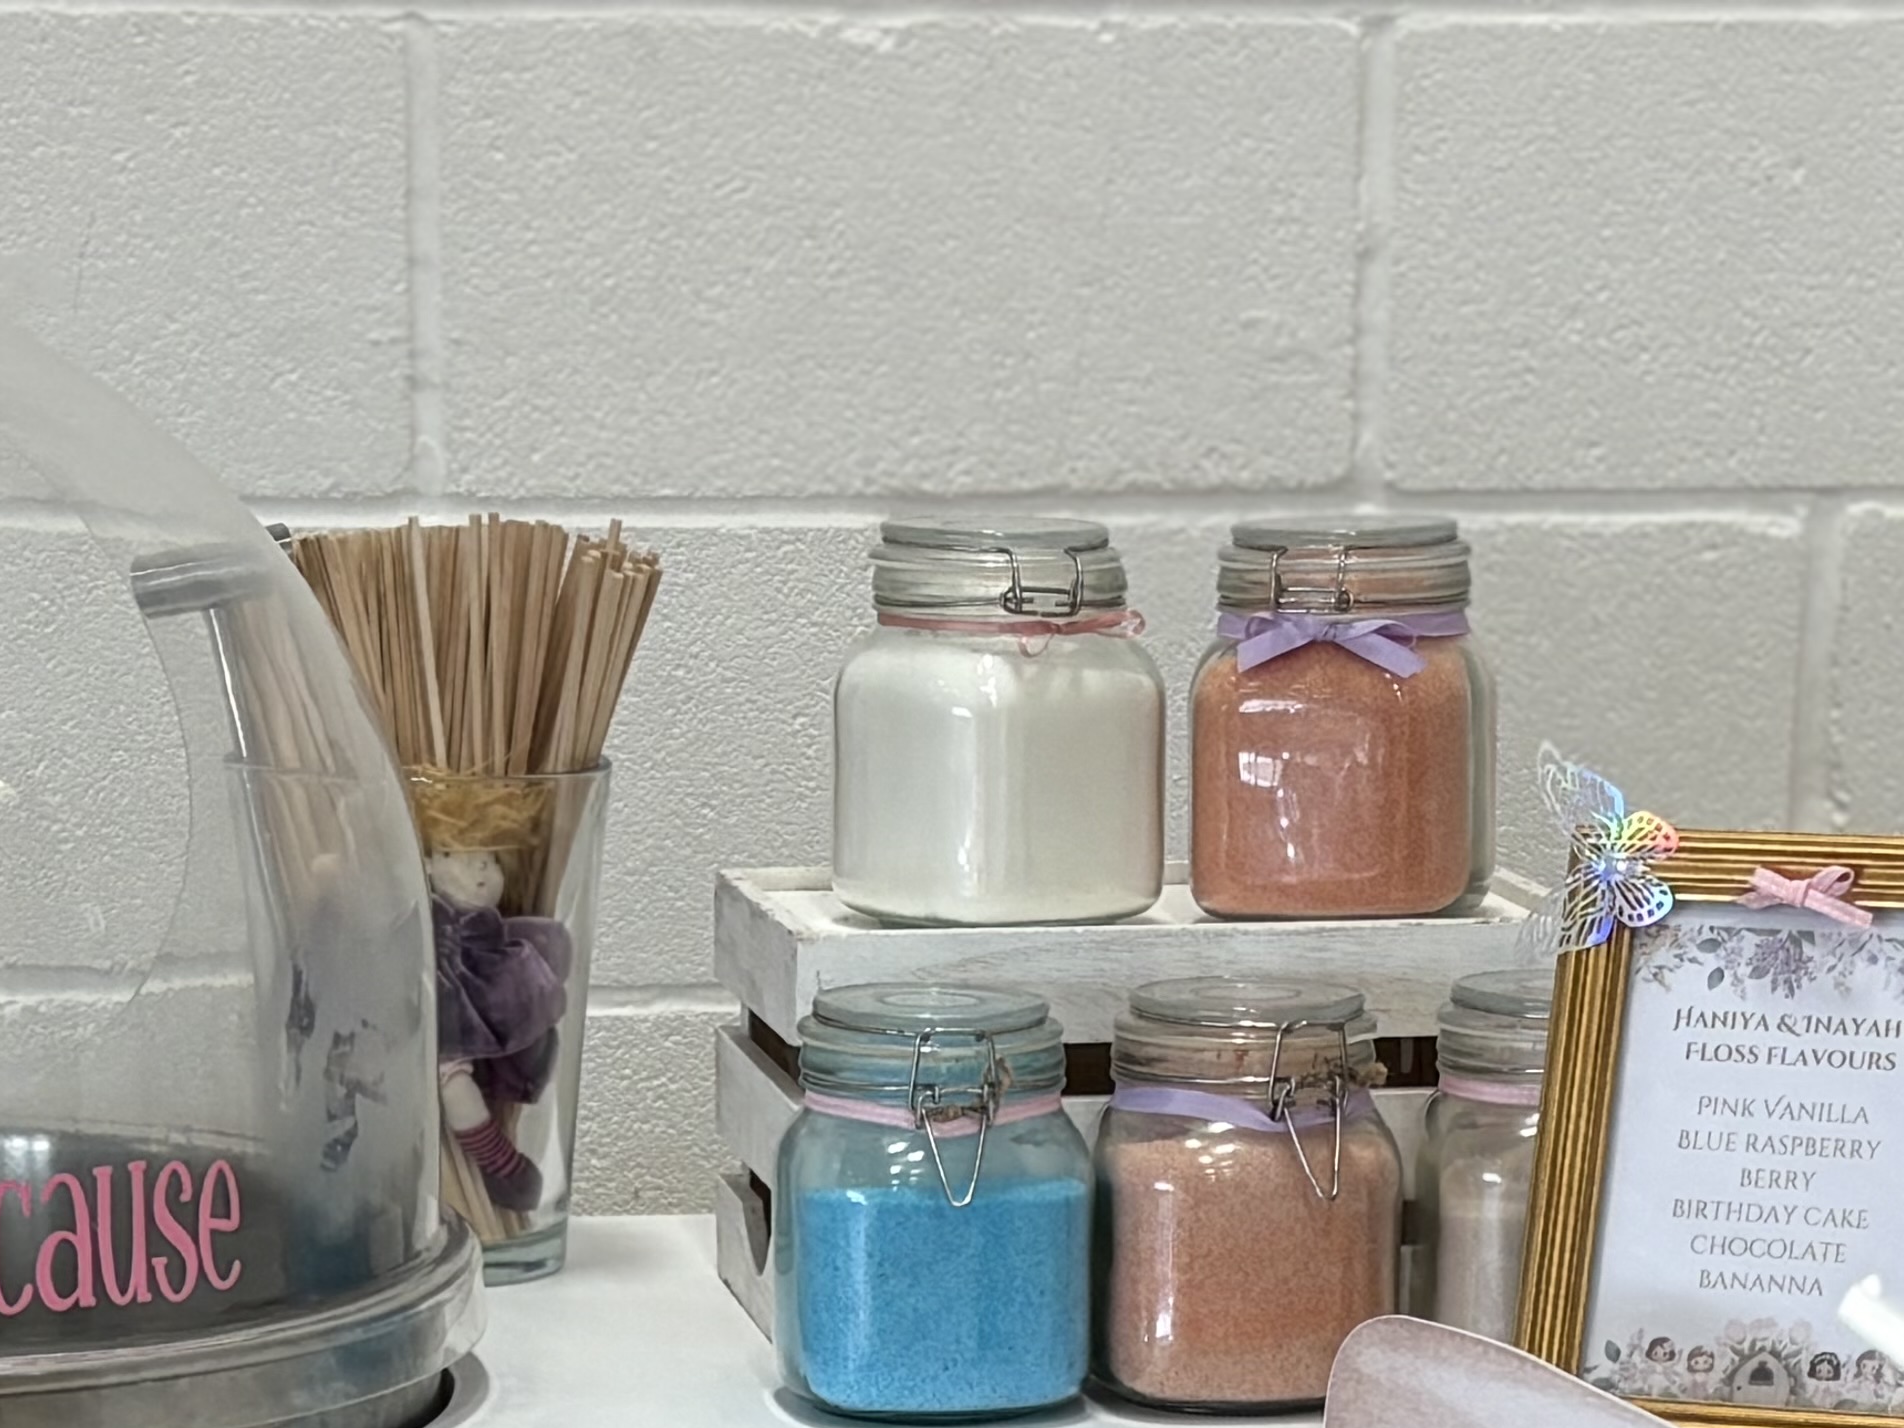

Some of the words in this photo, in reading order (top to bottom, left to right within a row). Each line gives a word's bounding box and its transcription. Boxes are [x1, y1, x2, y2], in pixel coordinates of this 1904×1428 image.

[1673, 1006, 1769, 1032] HANIYA
[1776, 1013, 1801, 1037] &
[1685, 1041, 1759, 1065] FLOSS
[1766, 1046, 1897, 1071] FLAVOURS
[1697, 1095, 1755, 1118] PINK
[1764, 1094, 1869, 1125] VANILLA
[1678, 1129, 1738, 1152] BLUE
[1745, 1133, 1881, 1160] RASPBERRY
[1740, 1167, 1817, 1192] BERRY
[1672, 1198, 1798, 1225] BIRTHDAY
[1803, 1206, 1870, 1230] CAKE
[1690, 1234, 1847, 1264] CHOCOLATE
[1699, 1269, 1823, 1297] BANANNA
